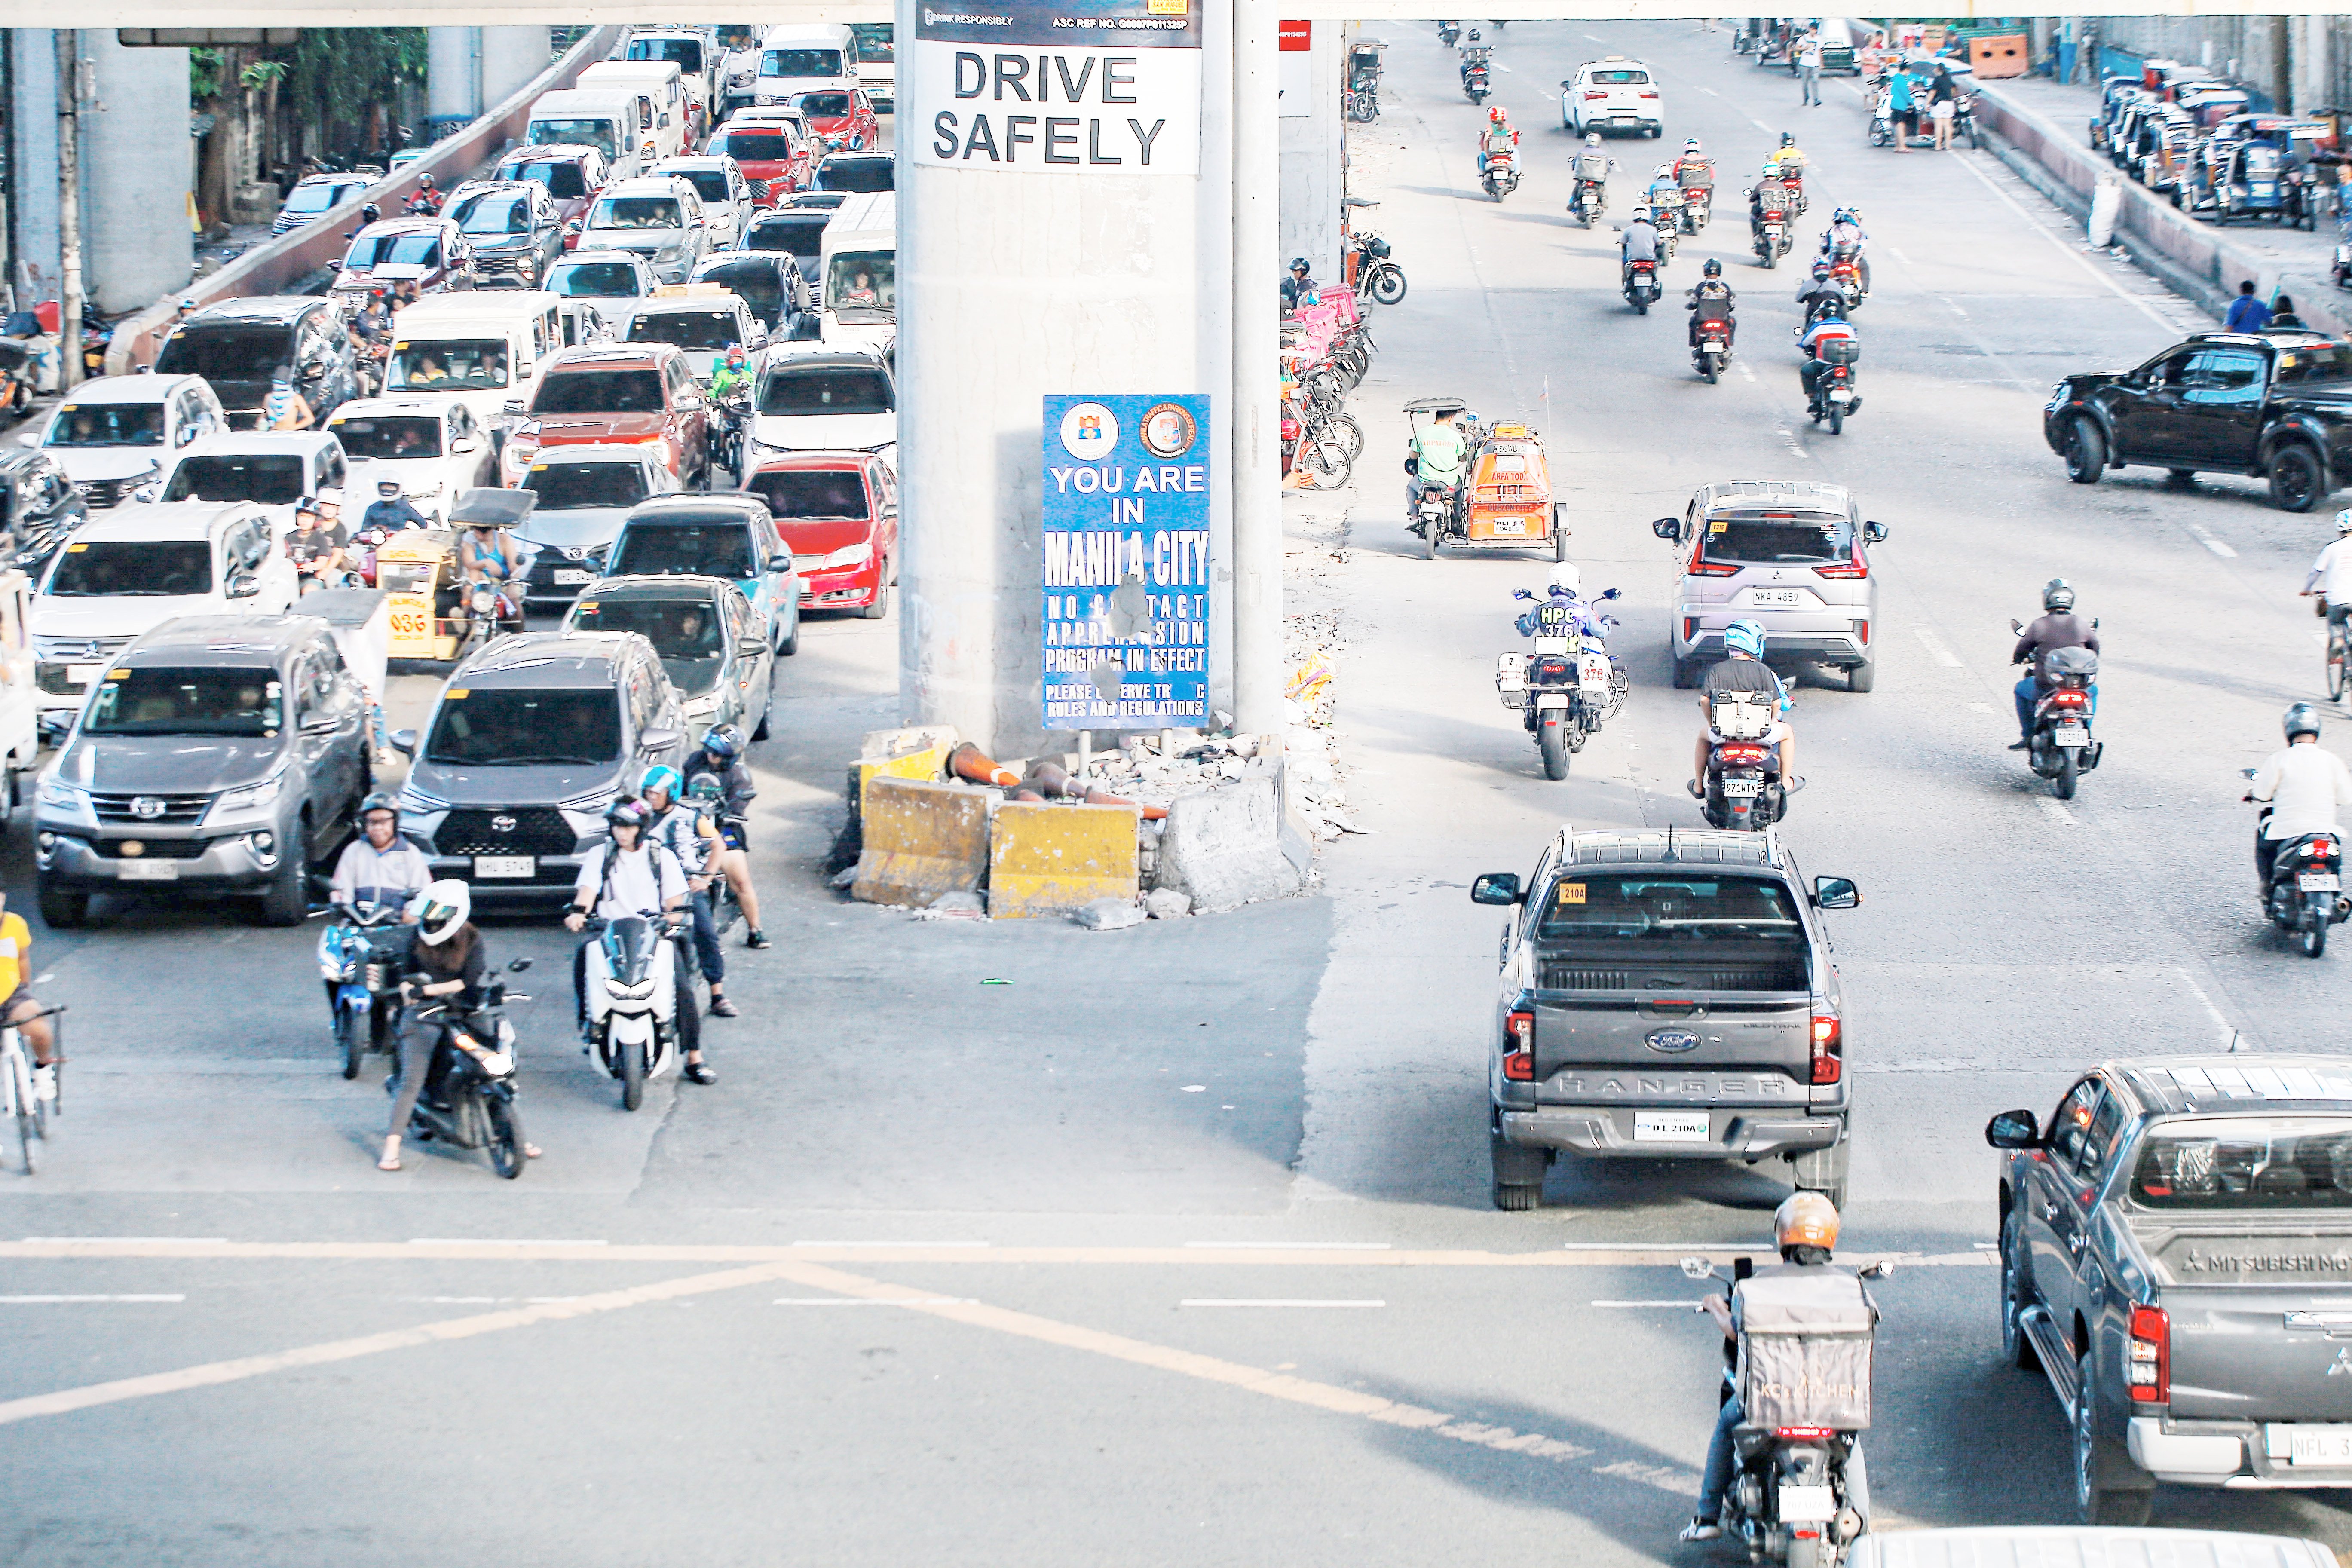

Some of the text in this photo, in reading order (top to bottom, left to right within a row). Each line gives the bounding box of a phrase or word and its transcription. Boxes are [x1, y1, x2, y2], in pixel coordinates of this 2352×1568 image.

[932, 13, 1014, 26] DRINK RESPONSIBLY
[1052, 18, 1075, 28] ASC
[1075, 18, 1097, 28] REF
[1098, 18, 1117, 29] NO.
[955, 52, 1137, 103] DRIVE
[934, 110, 1166, 165] SAFELY
[1049, 466, 1205, 494] YOU ARE
[1491, 472, 1509, 481] ARPA
[1112, 497, 1144, 524] IN
[1044, 530, 1209, 587] MANILA CITY
[1755, 592, 1799, 602] NKA 4859
[1047, 594, 1204, 619] NO CTACT
[1541, 607, 1577, 624] HPC
[1545, 624, 1574, 637] 376
[1045, 647, 1205, 672] PROGRAM IN EFFECT
[1046, 684, 1092, 700] PLEASE
[1047, 700, 1204, 717] RULES AND REGULATIONS
[1727, 784, 1755, 793] 971WTX
[1565, 888, 1584, 899] 210A
[1559, 1078, 1785, 1094] RANGER
[2208, 1254, 2315, 1272] MITSUBISHI
[1794, 1384, 1859, 1398] KITCHEN
[2295, 1439, 2327, 1456] NFL
